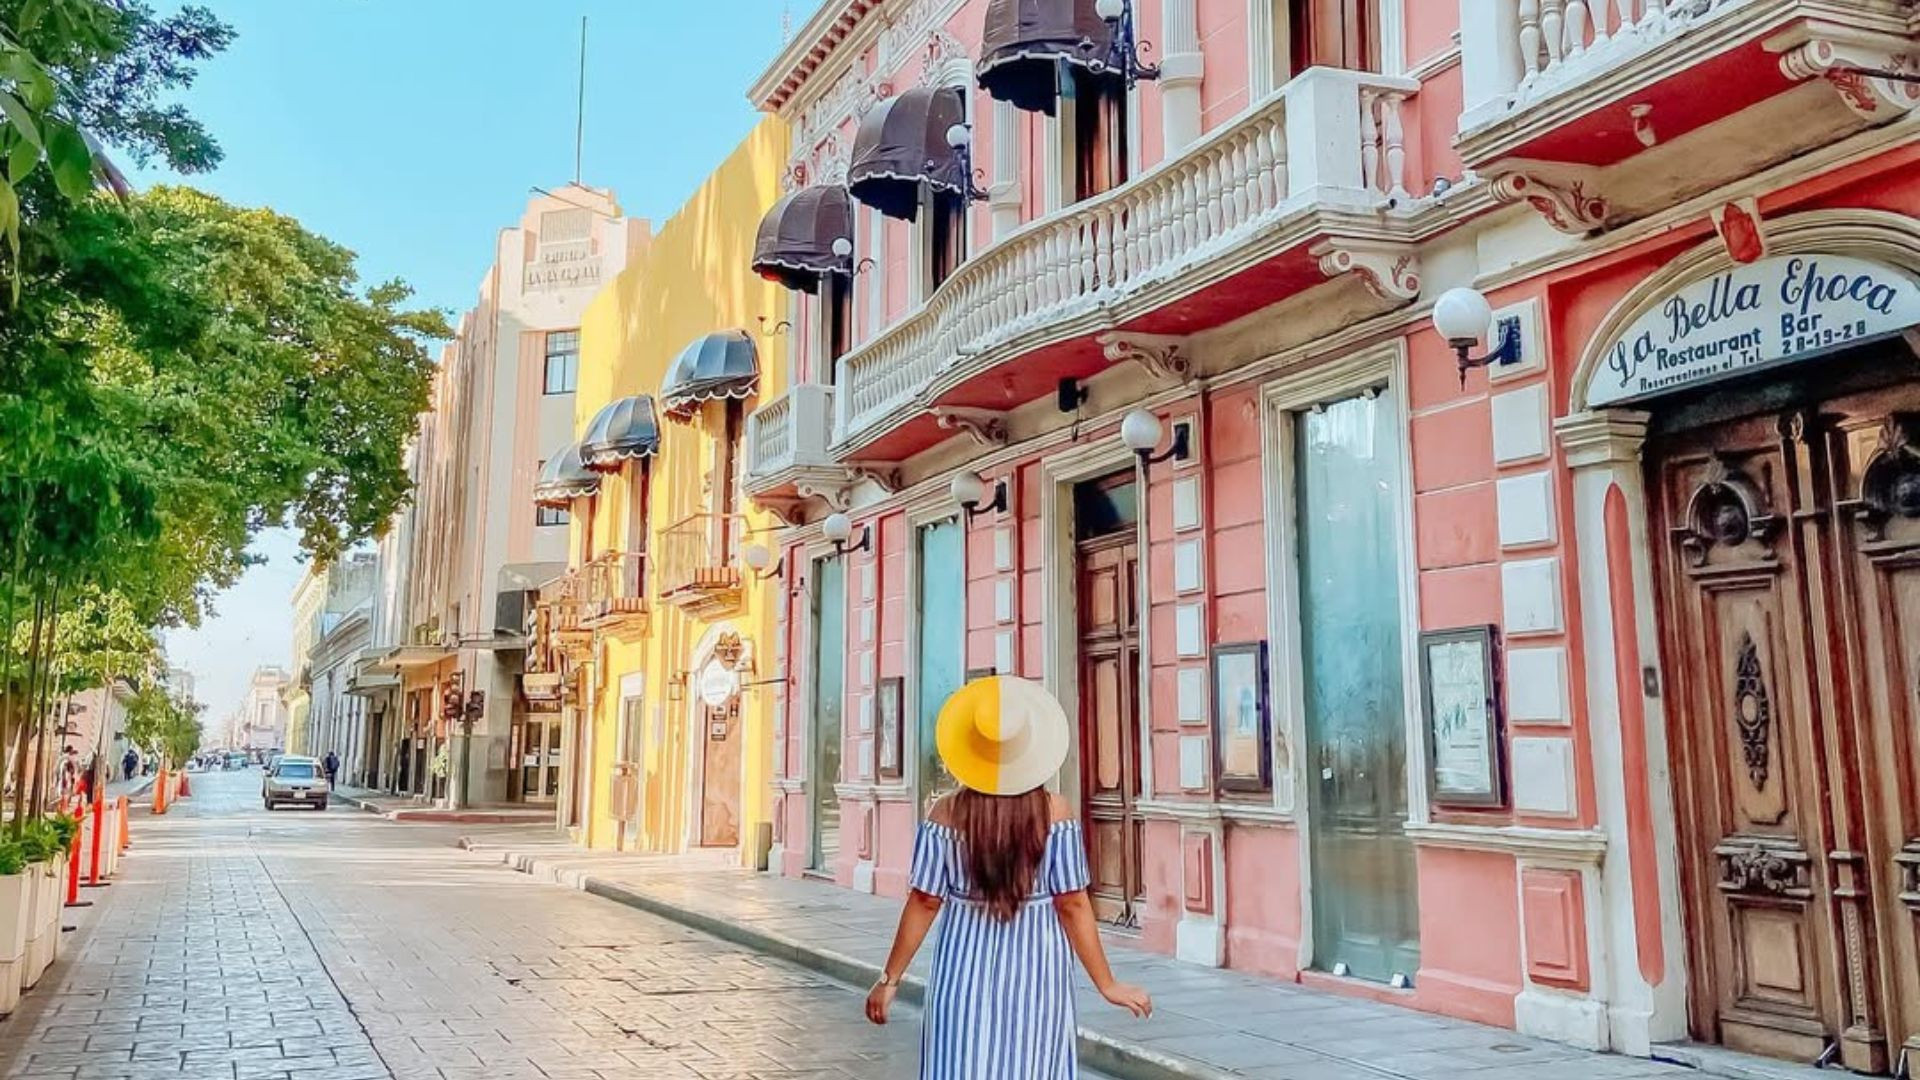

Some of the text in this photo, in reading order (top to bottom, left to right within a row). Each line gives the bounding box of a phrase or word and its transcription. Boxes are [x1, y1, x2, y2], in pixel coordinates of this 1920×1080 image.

[1609, 258, 1897, 387] La Bella Epoca
[1657, 312, 1823, 370] Restaurant Bar
